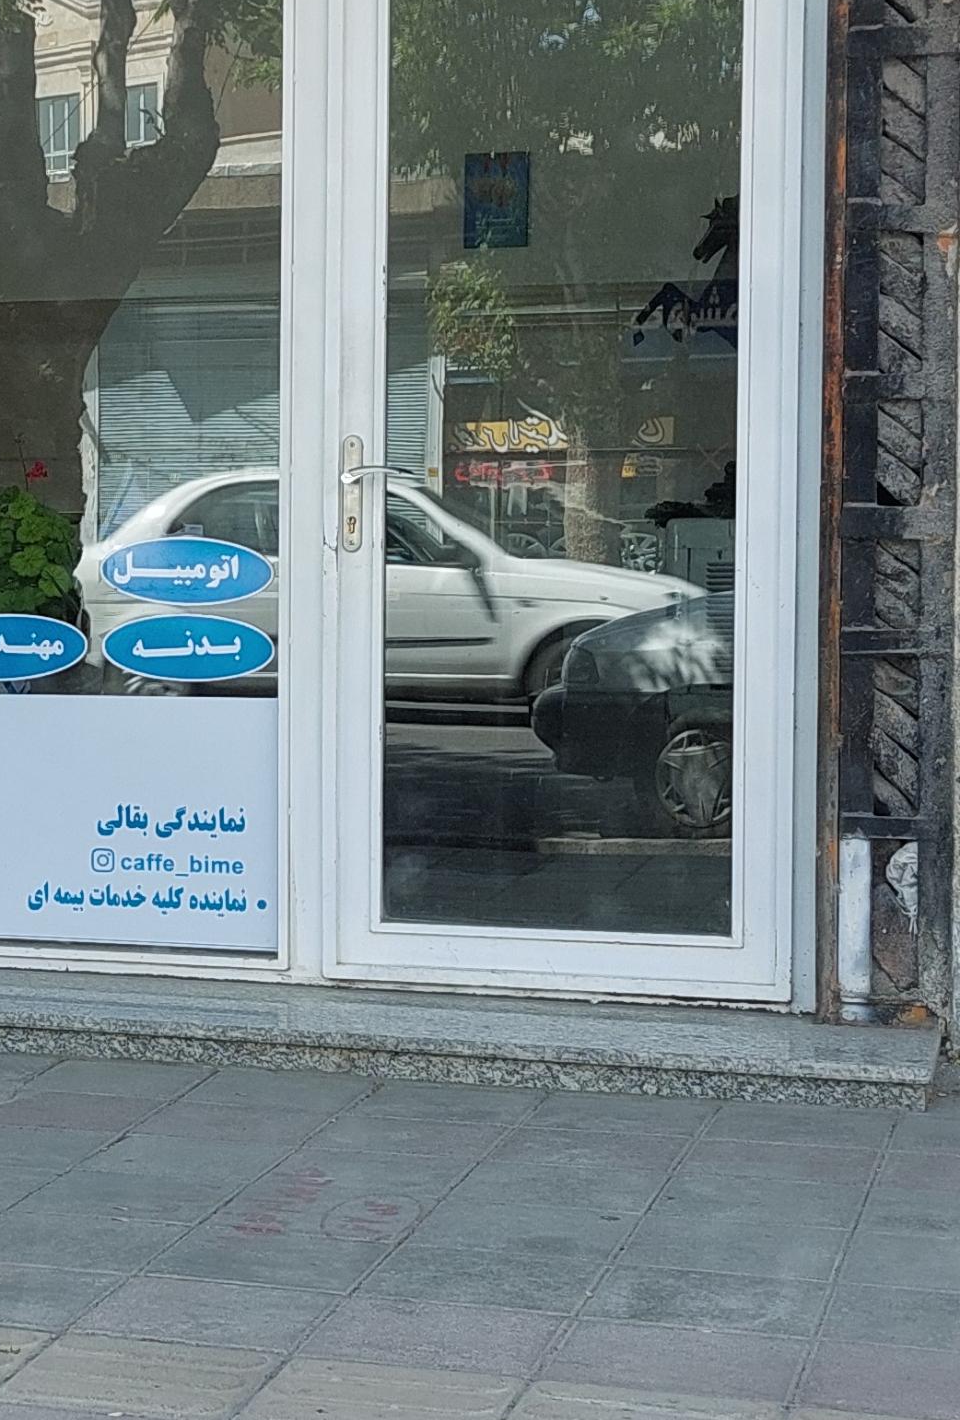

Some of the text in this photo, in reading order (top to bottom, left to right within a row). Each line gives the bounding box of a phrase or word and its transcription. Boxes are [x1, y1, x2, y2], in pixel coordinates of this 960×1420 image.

[114, 551, 238, 587] اتومبیل
[133, 631, 241, 660] بدنه
[98, 805, 245, 838] نمایندگی بقالی
[121, 854, 243, 877] caffe_bime
[28, 882, 246, 917] نماینده کلیه خدمات بیمه ای
